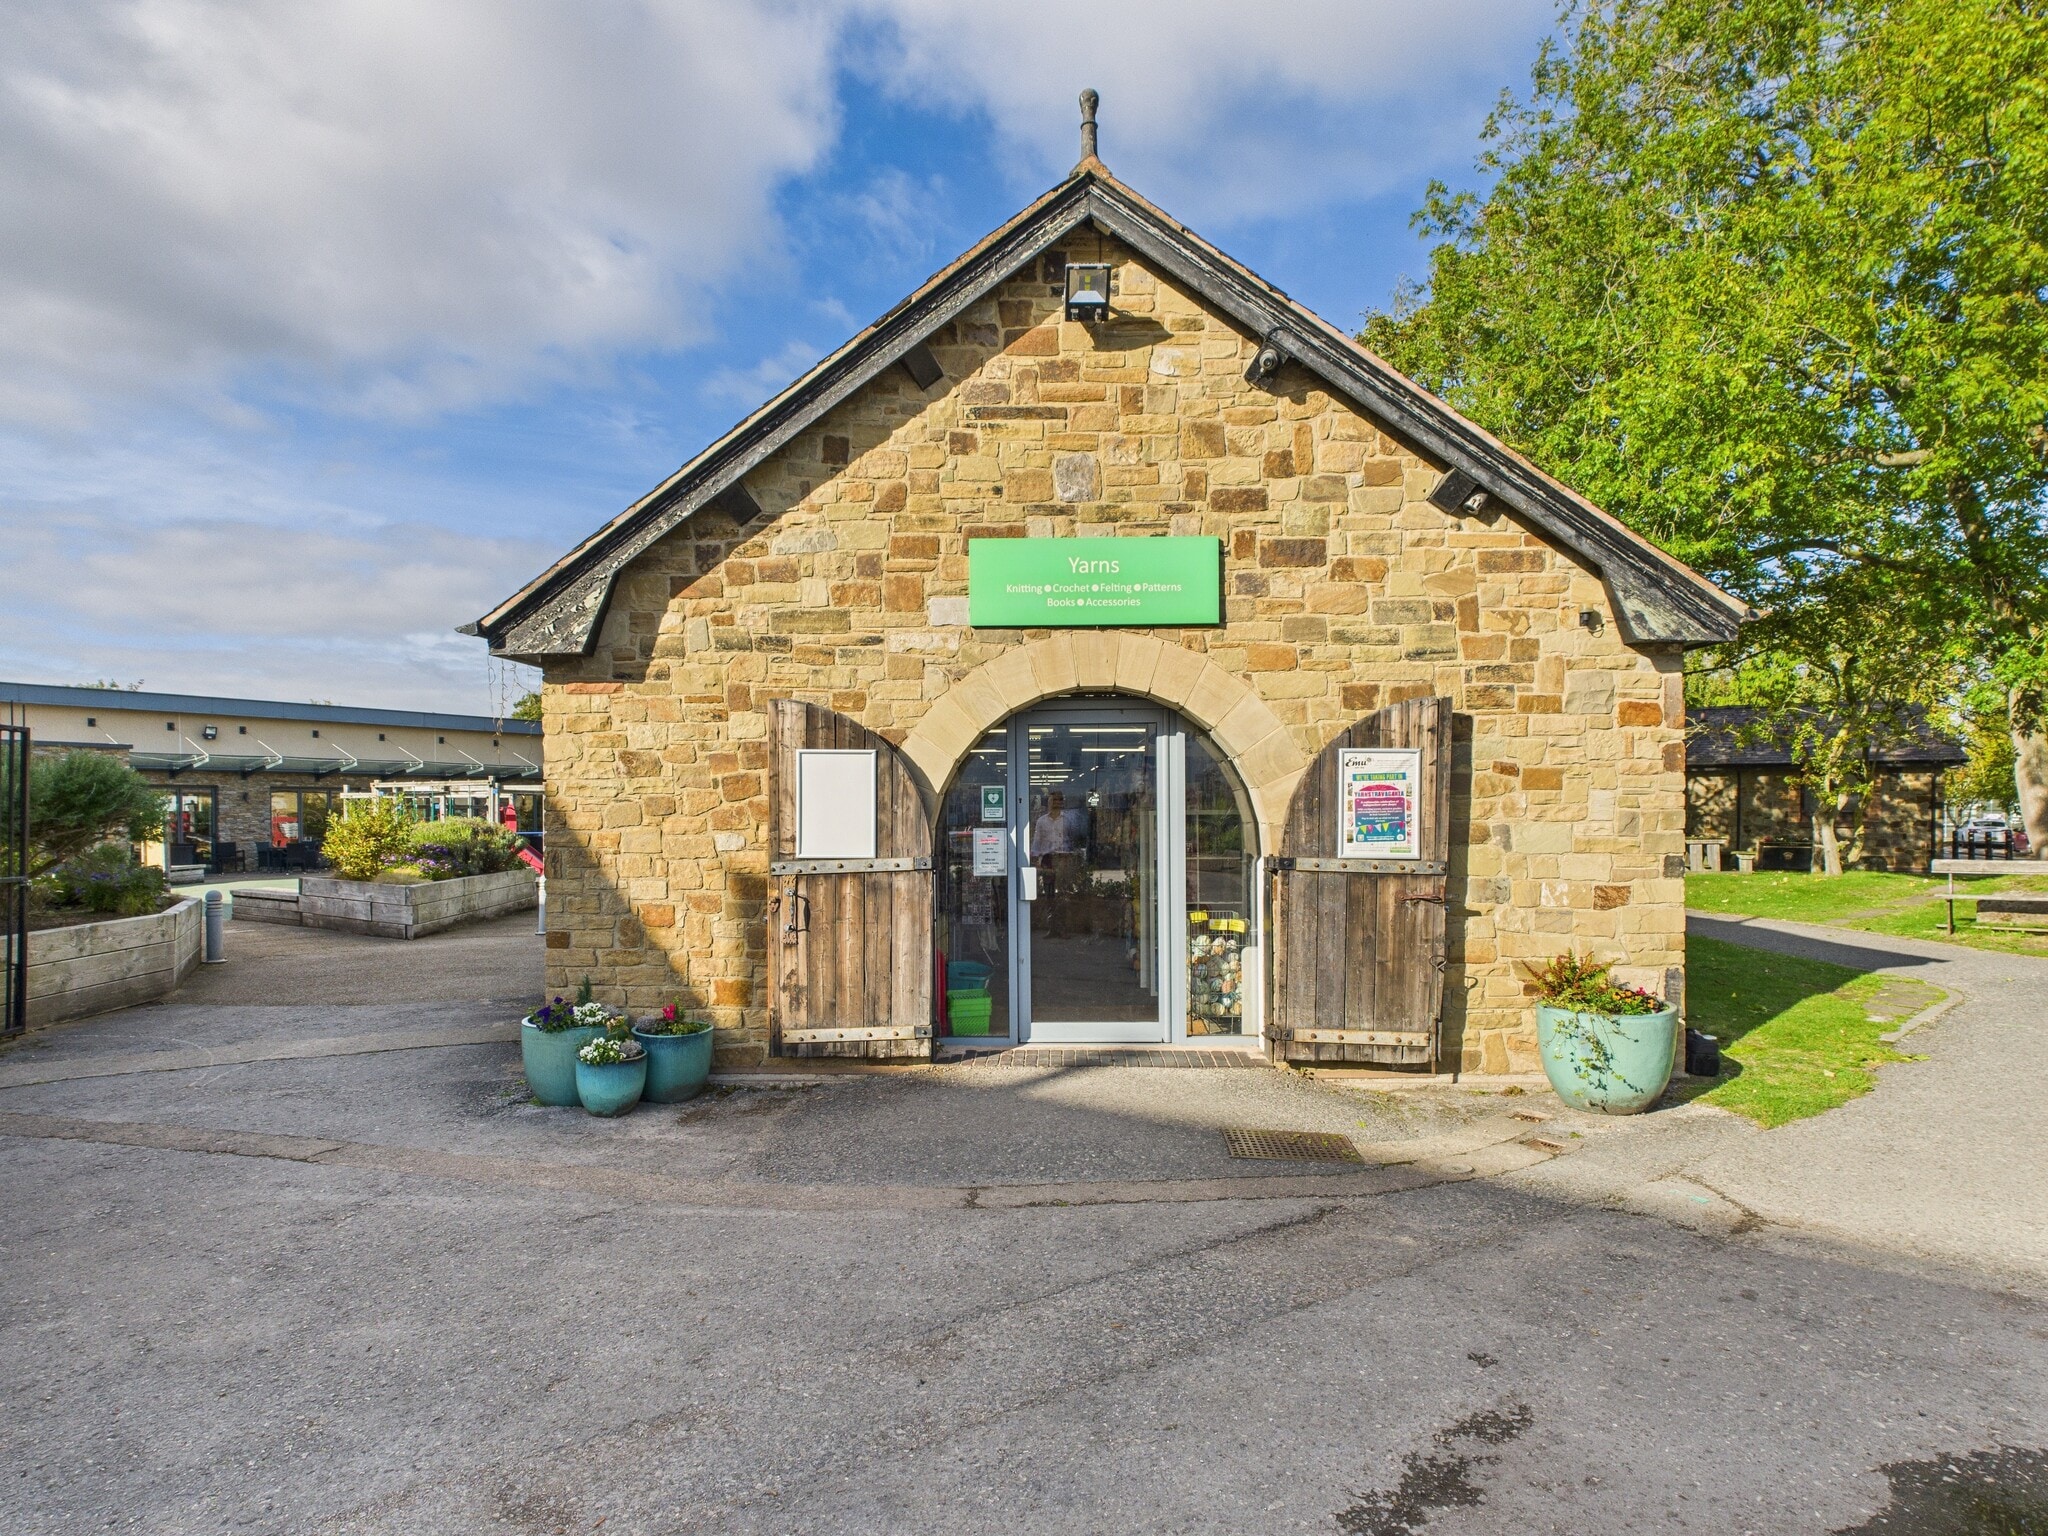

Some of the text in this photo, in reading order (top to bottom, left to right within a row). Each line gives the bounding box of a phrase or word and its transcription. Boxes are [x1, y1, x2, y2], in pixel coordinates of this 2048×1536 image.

[1068, 556, 1120, 574] Yarns
[1006, 582, 1182, 595] Knitting Crochet Felting Patterns
[1047, 597, 1141, 607] Books Accessories
